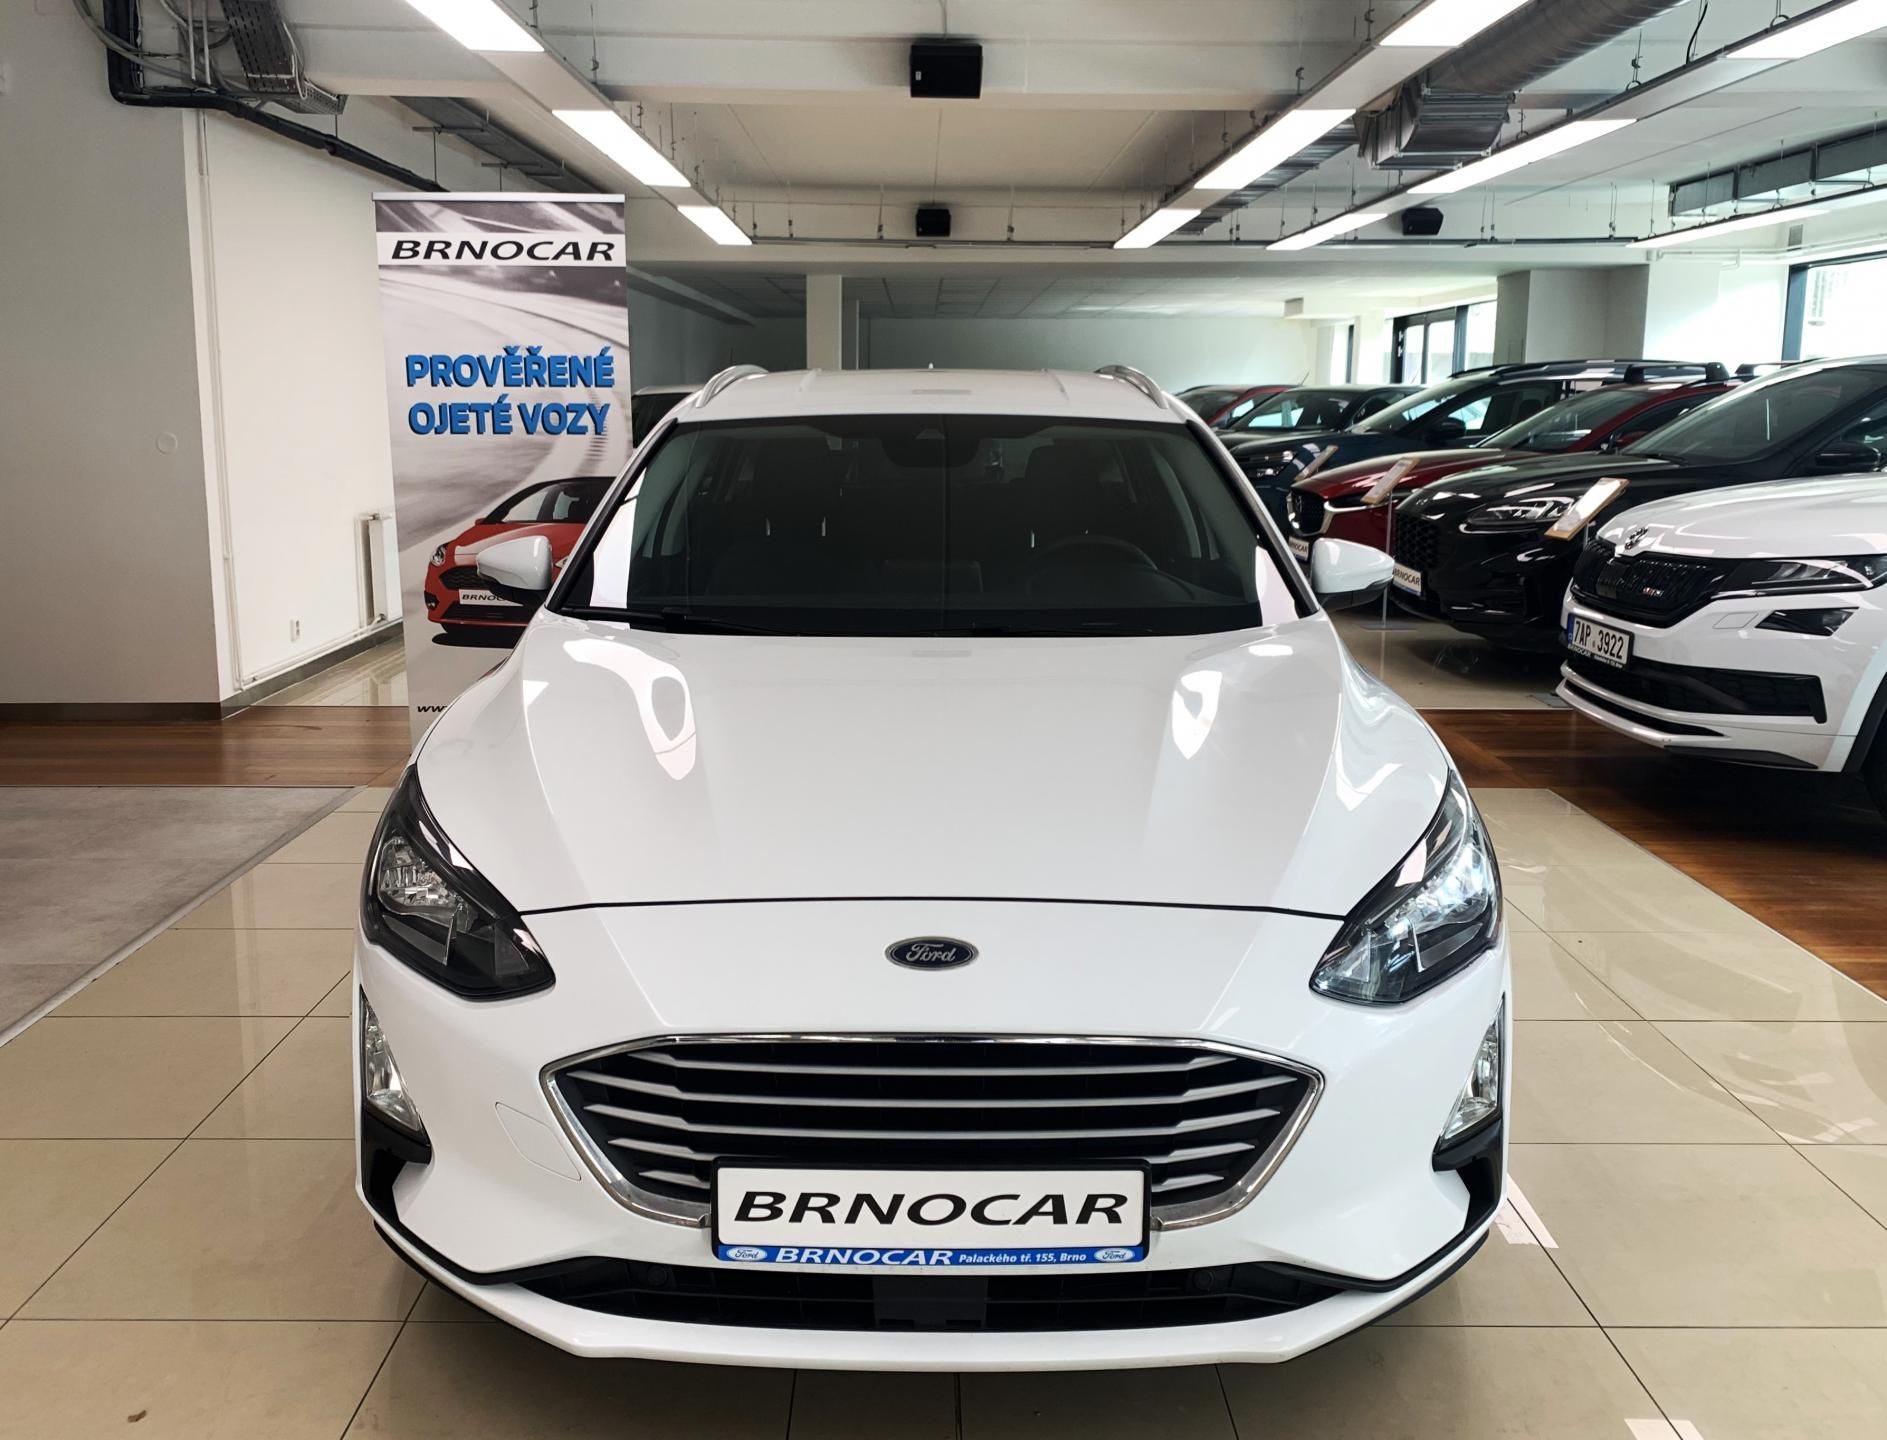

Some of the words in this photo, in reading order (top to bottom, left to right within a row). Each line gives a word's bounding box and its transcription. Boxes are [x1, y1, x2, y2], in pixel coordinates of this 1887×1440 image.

[391, 239, 616, 262] BRNOCAR
[405, 345, 615, 388] PROVĚŘENÉ
[408, 393, 513, 436] OJETÉ
[517, 402, 611, 436] VOZY
[1574, 620, 1592, 647] 7AP
[1597, 629, 1624, 660] 3922
[905, 943, 957, 962] Ford
[734, 1190, 1128, 1226] BRNOCAR
[775, 1247, 953, 1265] BRNOCAR
[959, 1252, 1017, 1263] Palackého
[1020, 1252, 1032, 1263] tř.
[1035, 1253, 1057, 1264] 155,
[1060, 1252, 1087, 1262] Brno
